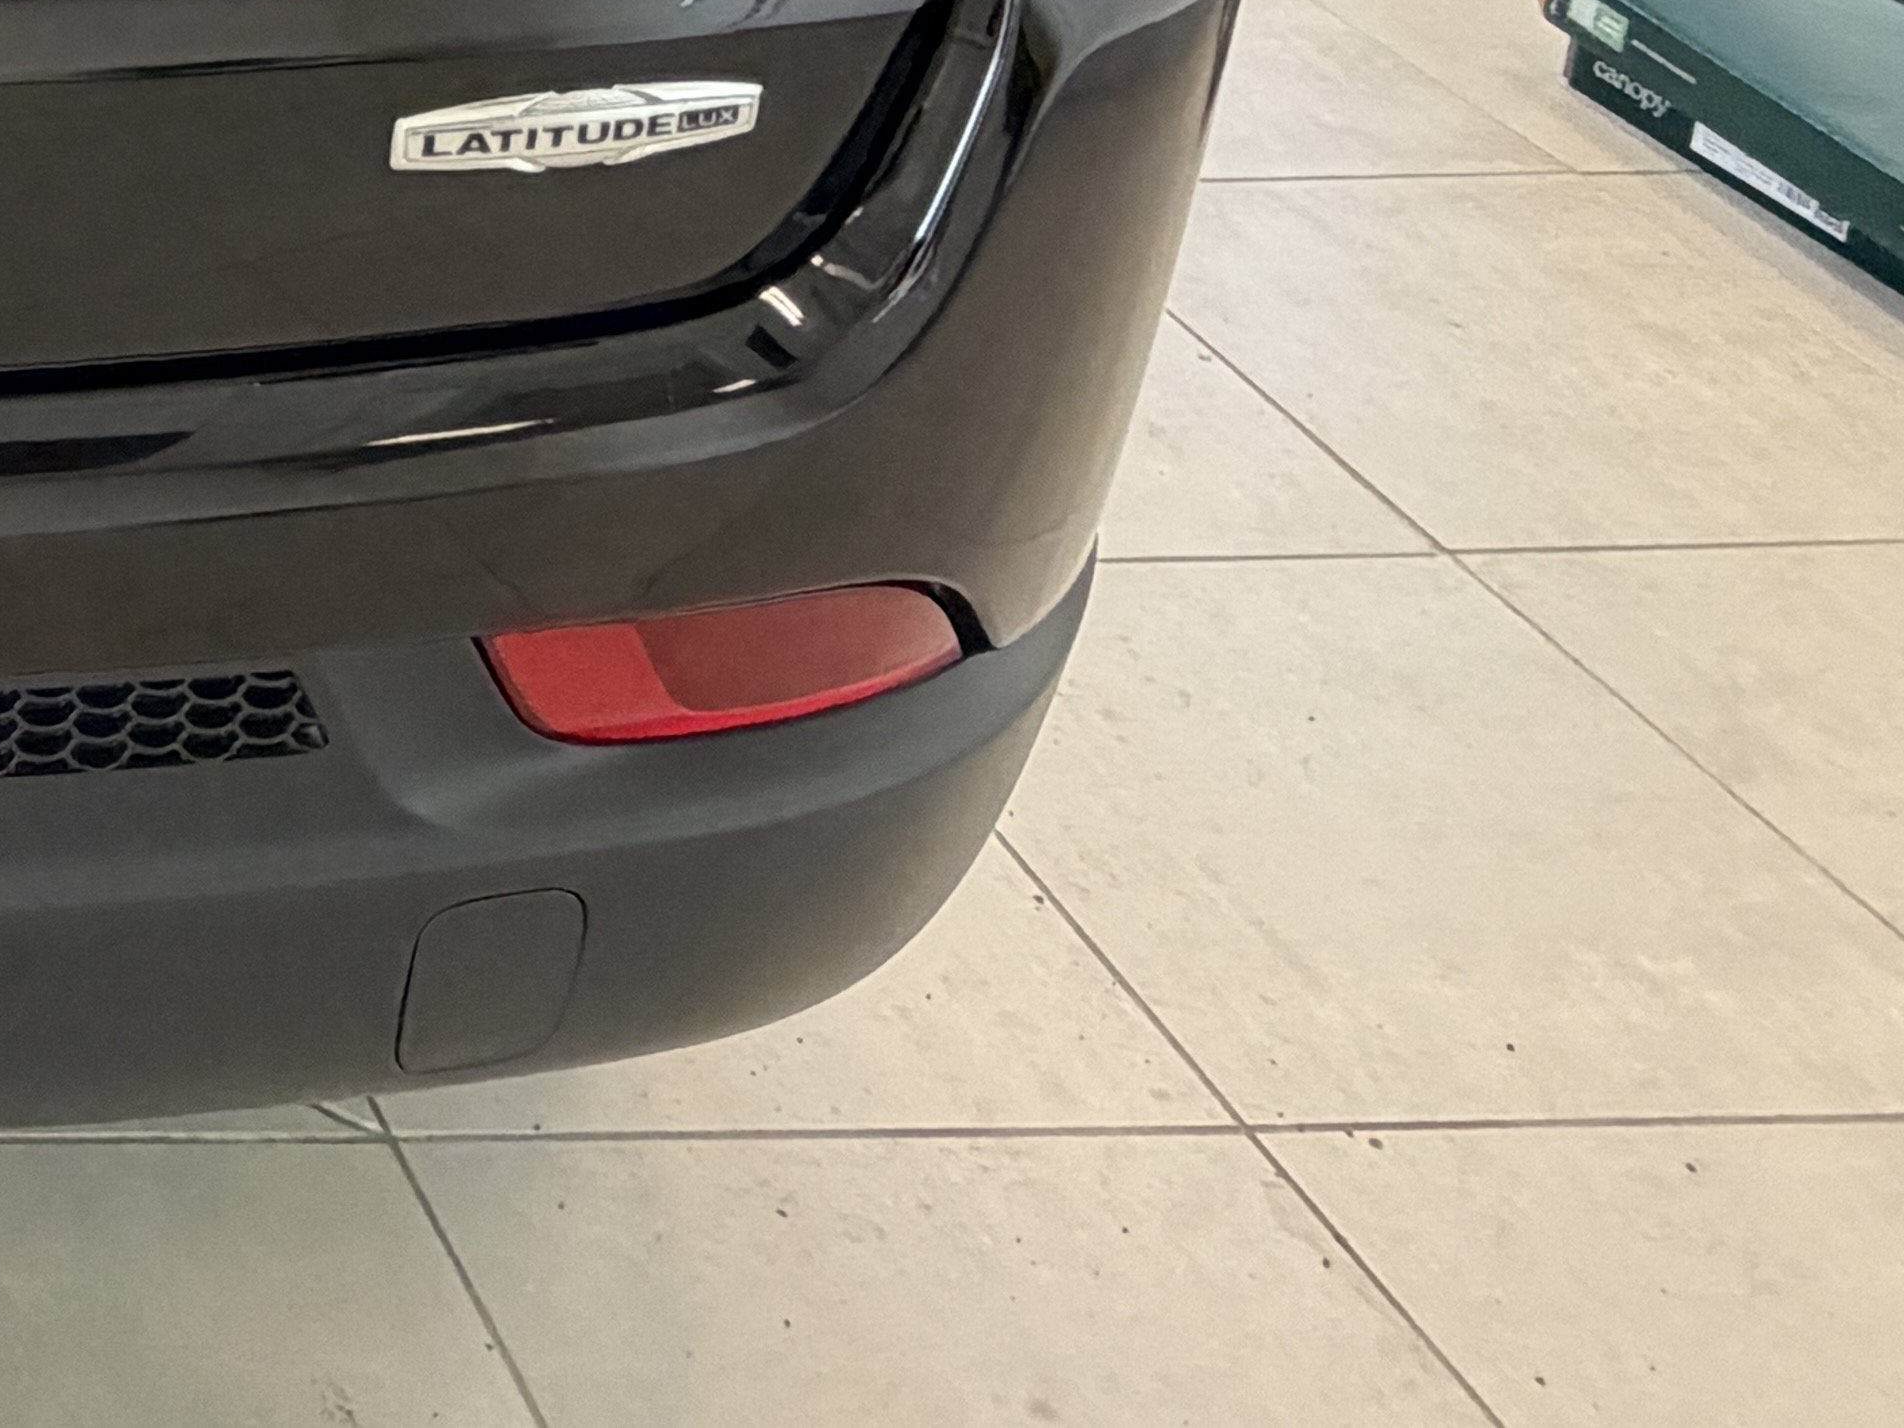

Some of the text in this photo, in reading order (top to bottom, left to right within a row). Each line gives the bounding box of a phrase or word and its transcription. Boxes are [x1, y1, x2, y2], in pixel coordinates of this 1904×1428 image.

[1592, 59, 1672, 118] canopy
[421, 105, 737, 158] LATITUDE LUX
